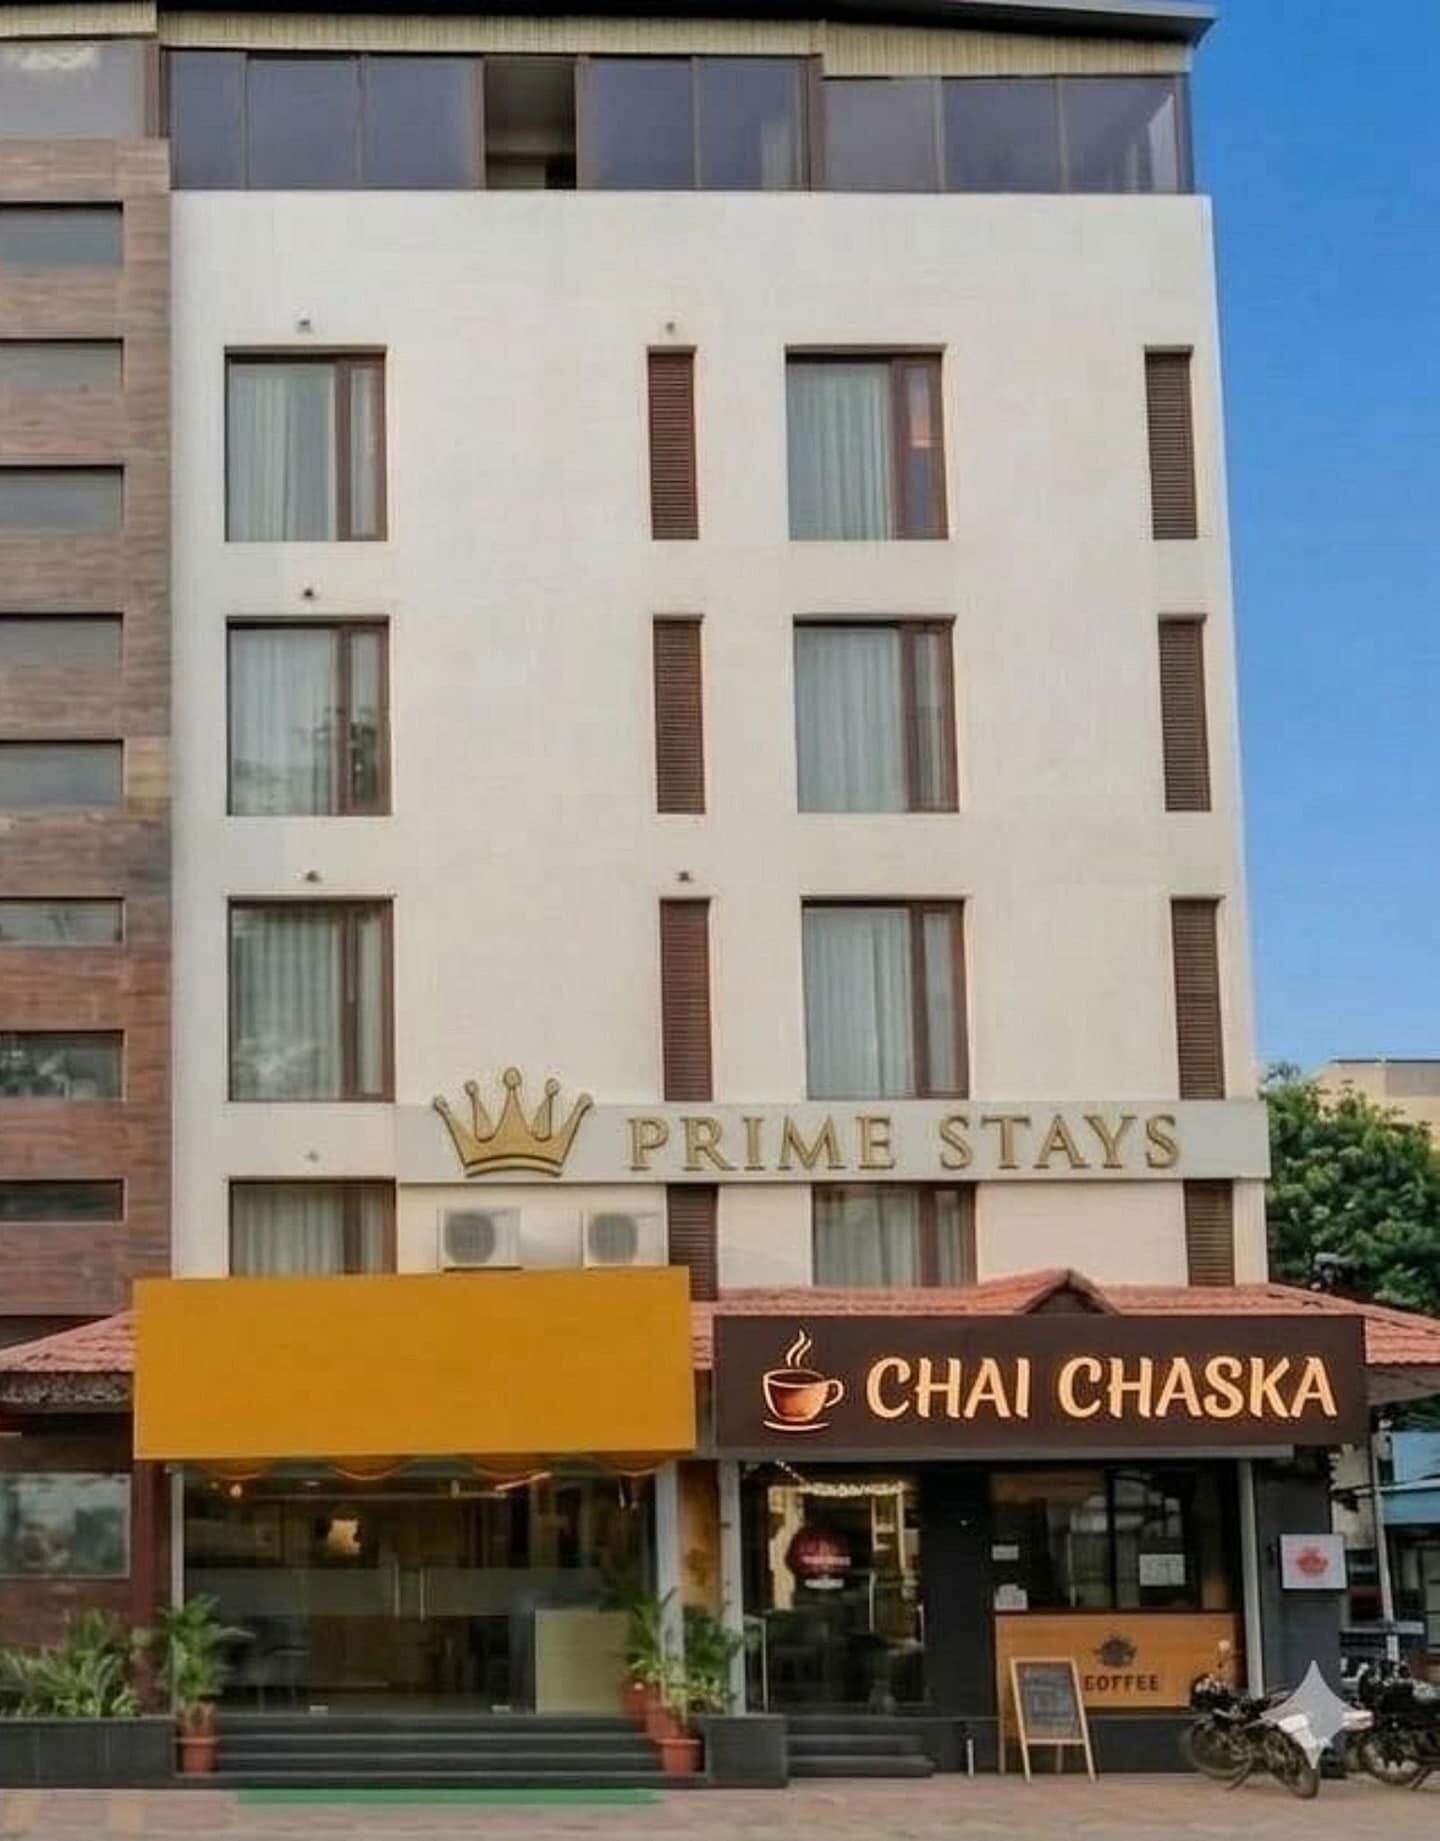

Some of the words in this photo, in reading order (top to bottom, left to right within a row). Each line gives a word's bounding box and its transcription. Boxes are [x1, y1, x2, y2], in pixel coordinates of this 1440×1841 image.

[626, 1115, 897, 1173] PRIME
[938, 1114, 1182, 1171] STAYS
[865, 1356, 1032, 1419] CHAI
[1057, 1356, 1338, 1419] CHASKA
